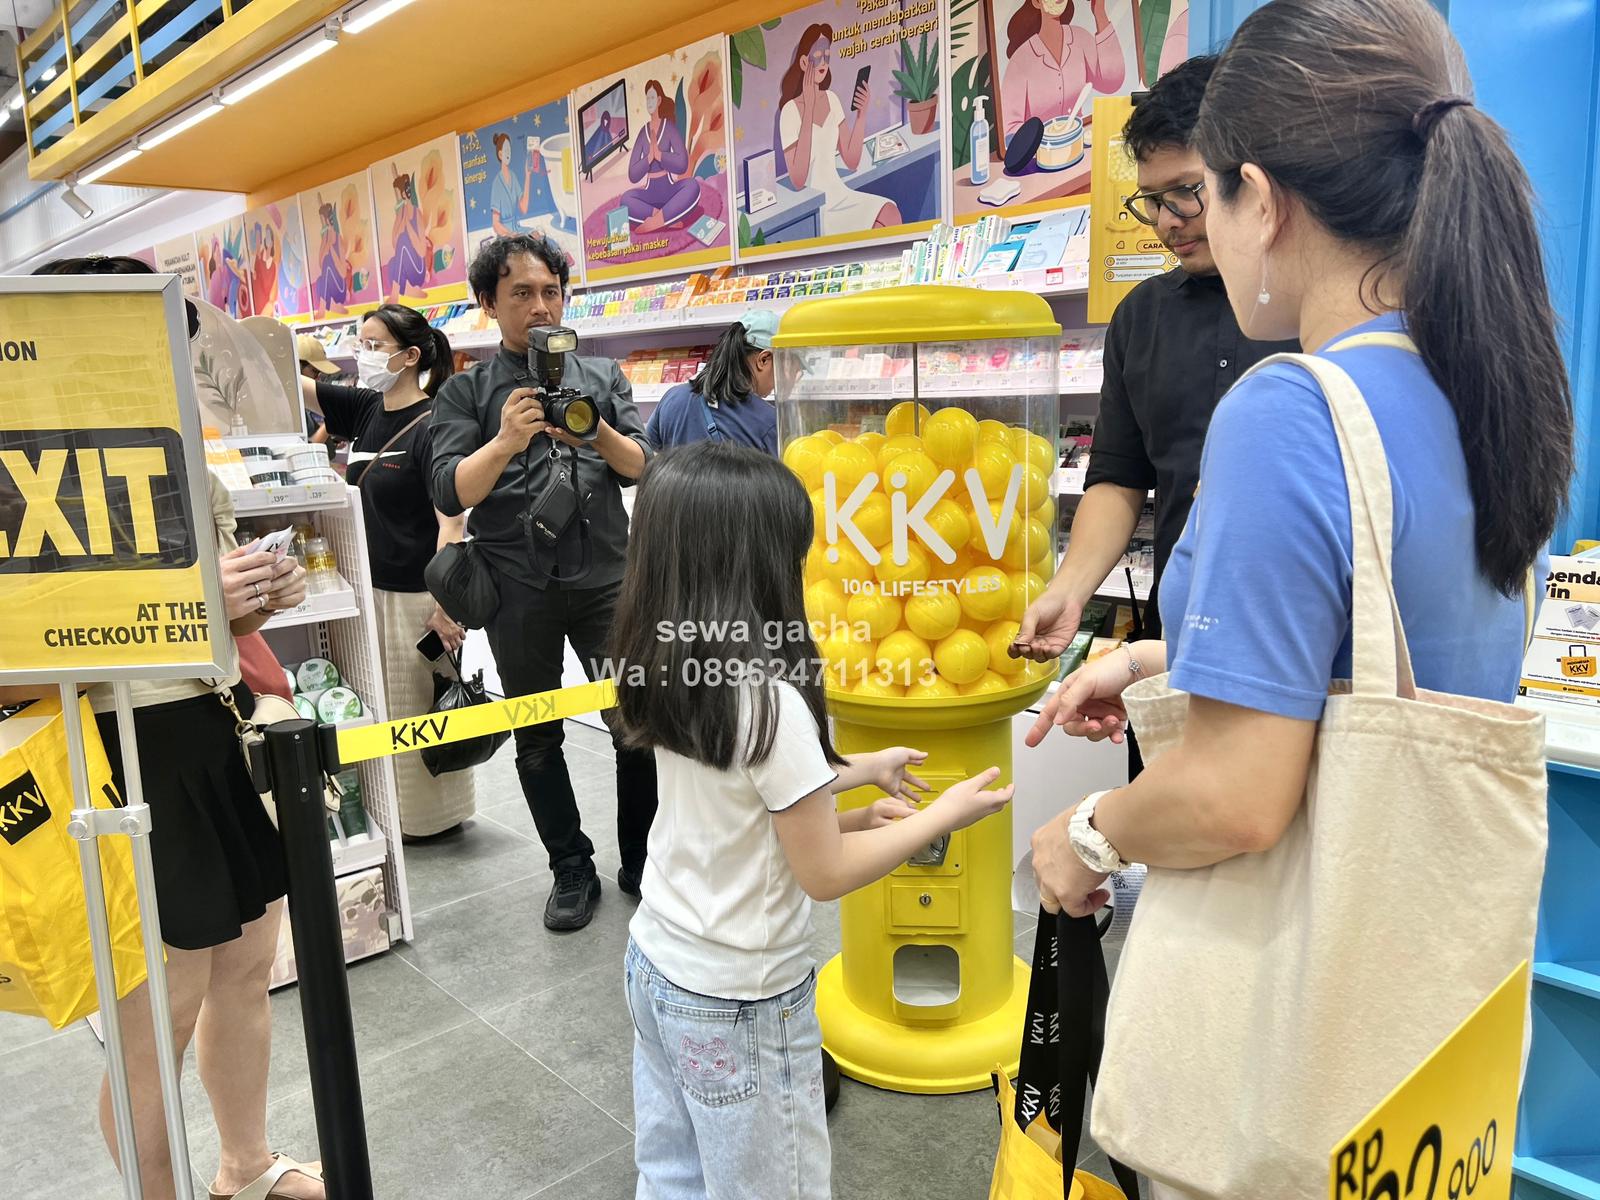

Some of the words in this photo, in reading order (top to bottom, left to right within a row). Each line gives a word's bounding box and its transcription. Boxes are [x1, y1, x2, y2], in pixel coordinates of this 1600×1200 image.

[832, 21, 862, 42] untuk
[863, 2, 936, 32] mendapatkan
[839, 40, 868, 58] wajah
[870, 29, 899, 49] cerah
[900, 16, 939, 39] berseri
[588, 245, 622, 261] kebebasan
[623, 240, 643, 256] pakai
[643, 237, 670, 251] masker
[1142, 242, 1164, 250] CARA
[0, 446, 168, 558] XIT
[823, 463, 1025, 567] KKV
[841, 578, 875, 596] 100
[880, 575, 1001, 598] LIFESTYLES
[136, 603, 160, 622] AT
[165, 601, 208, 620] THE
[44, 625, 158, 648] CHECKOUT
[168, 623, 208, 643] EXIT
[390, 715, 449, 751] KKV
